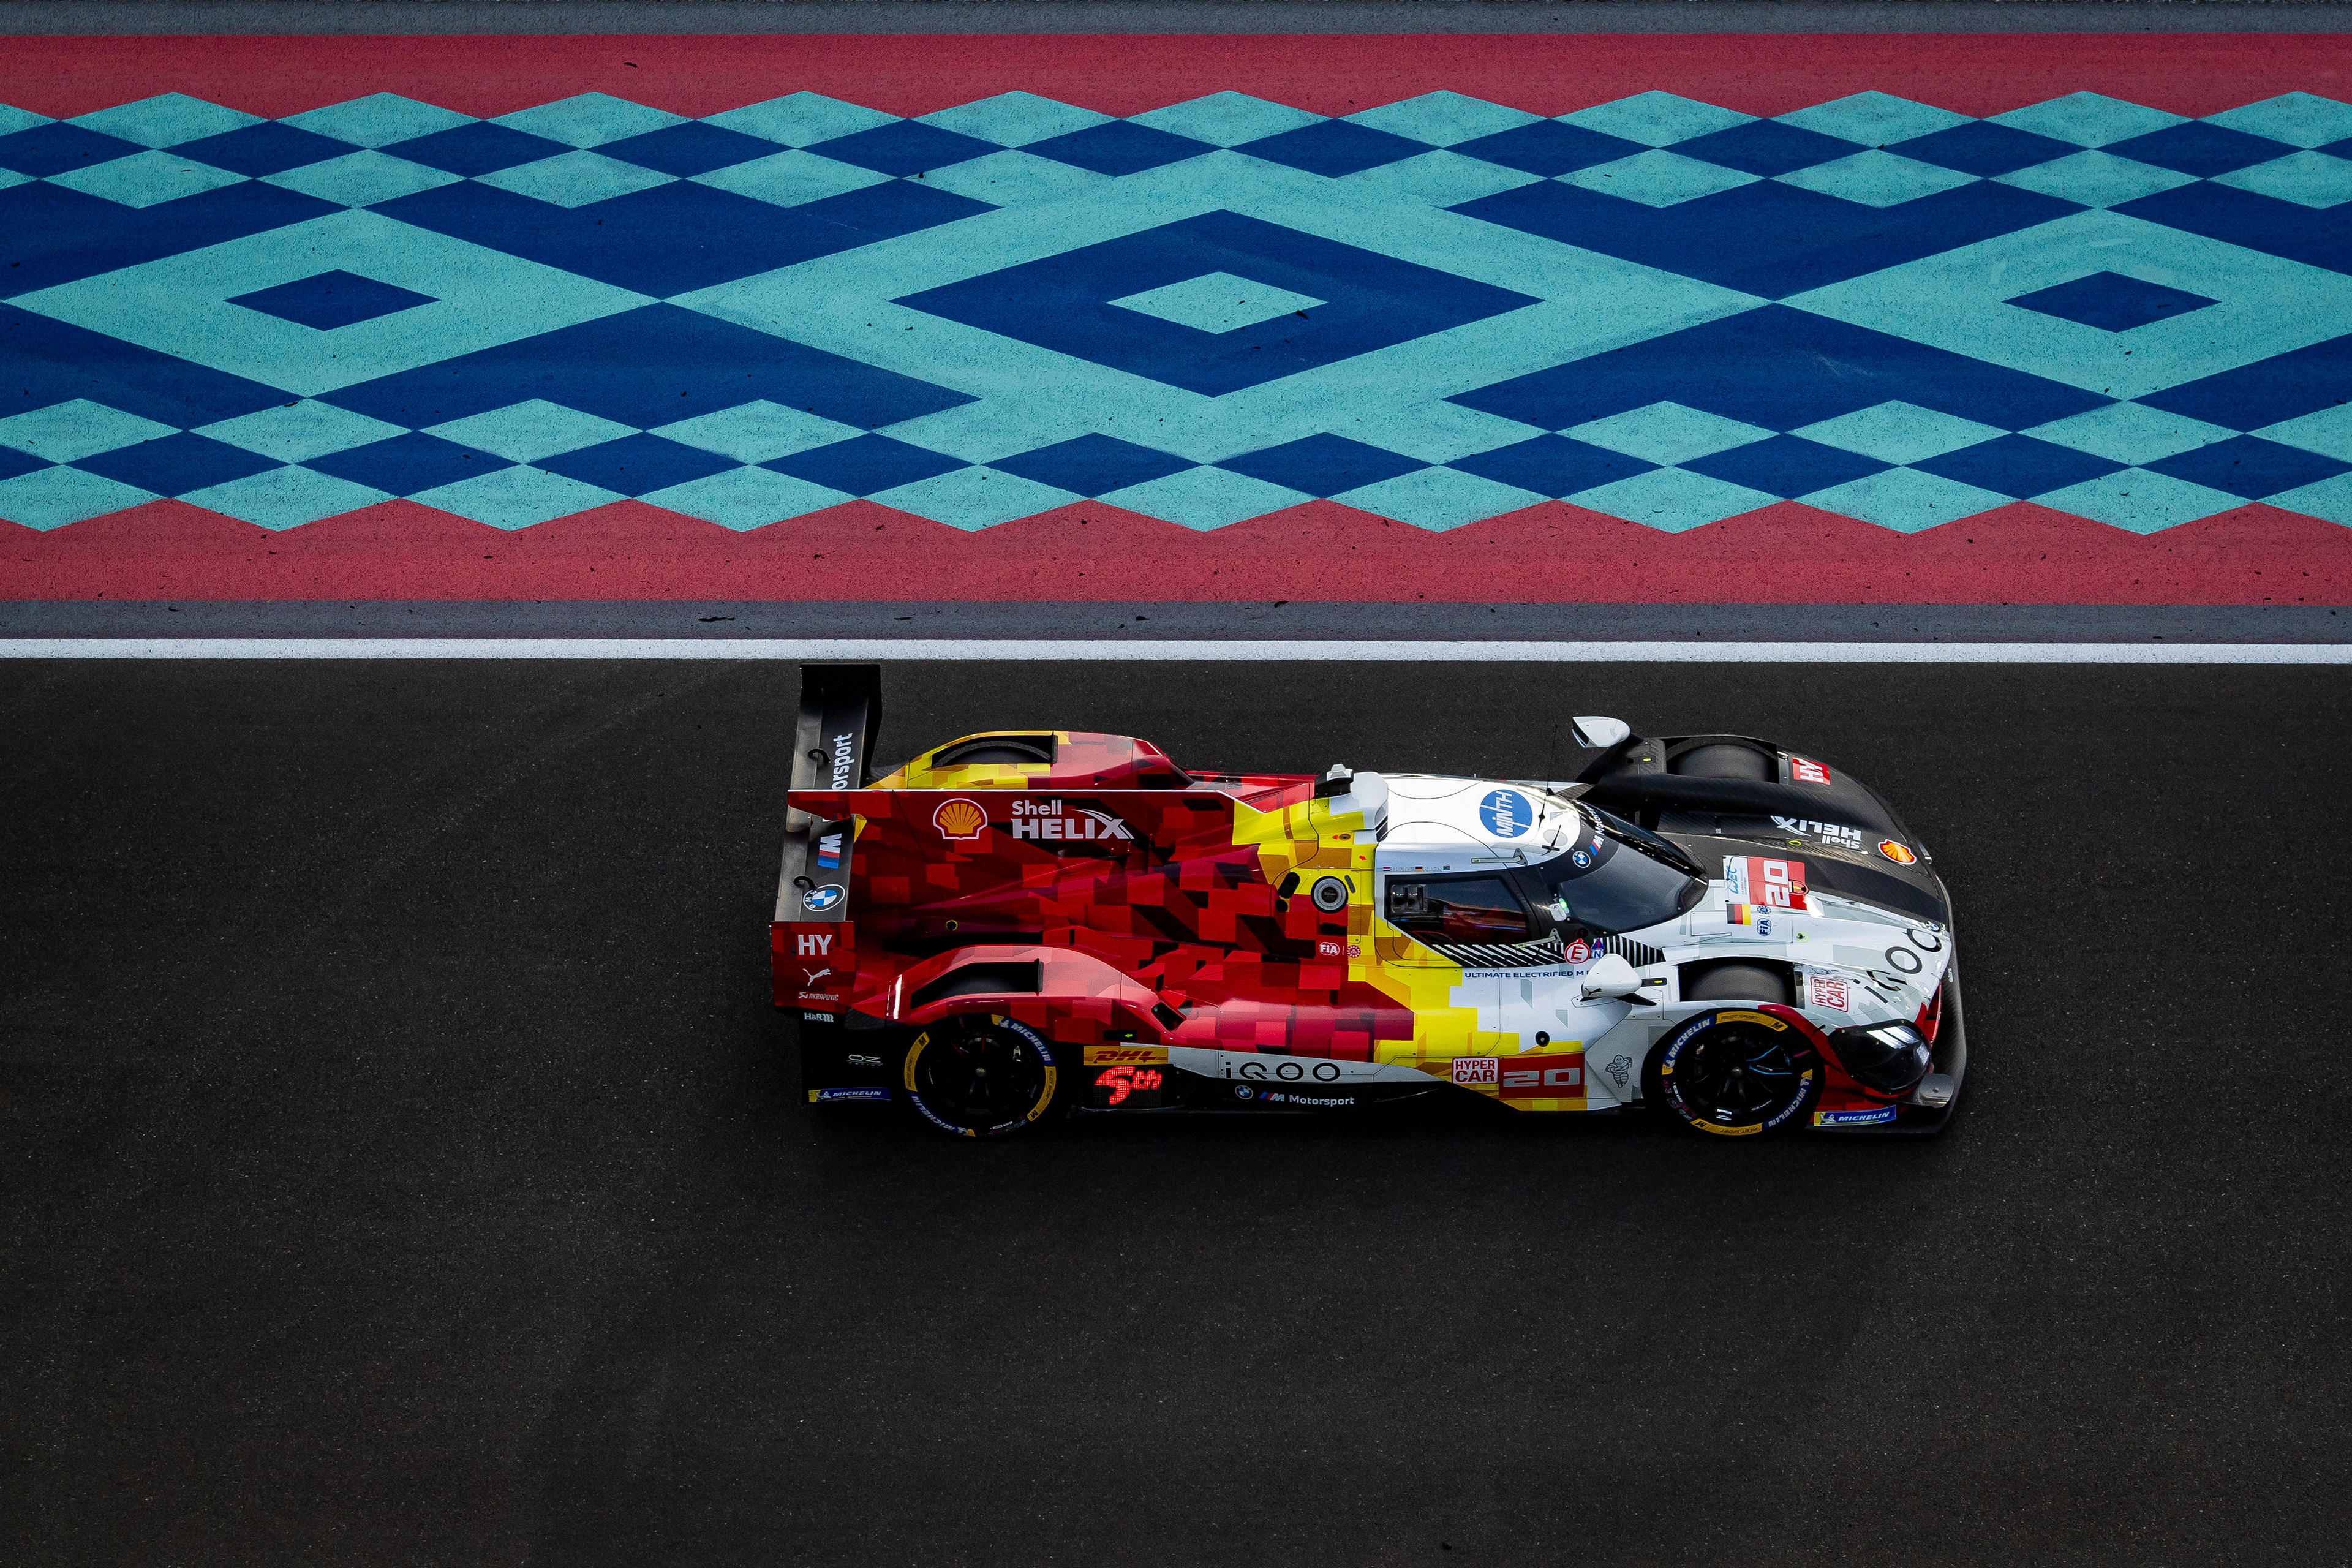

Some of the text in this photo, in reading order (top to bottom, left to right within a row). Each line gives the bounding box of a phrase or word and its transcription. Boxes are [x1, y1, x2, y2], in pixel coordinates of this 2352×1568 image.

[832, 733, 853, 790] orsport
[1012, 800, 1062, 815] Shell
[1011, 816, 1134, 839] HELIX
[1770, 815, 1862, 841] HELIX
[1822, 835, 1860, 849] Shell
[1763, 859, 1791, 907] 20
[798, 935, 832, 955] HY
[1570, 946, 1583, 960] E
[1814, 979, 1826, 1004] HYPER
[1826, 981, 1845, 1008] CAR
[1011, 1022, 1052, 1062] MICHELIN
[1670, 1019, 1711, 1058] MICHELIN
[1094, 1050, 1157, 1061] DHL
[1455, 1060, 1495, 1070] HYPER
[1455, 1069, 1495, 1082] CAR
[1503, 1068, 1580, 1087] 20
[1289, 1095, 1355, 1107] Motorsport
[1768, 1087, 1807, 1128] MICHELIN
[911, 1096, 956, 1132] MICHELIN
[1030, 1110, 1039, 1119] M
[1838, 1111, 1890, 1121] MICHELIN
